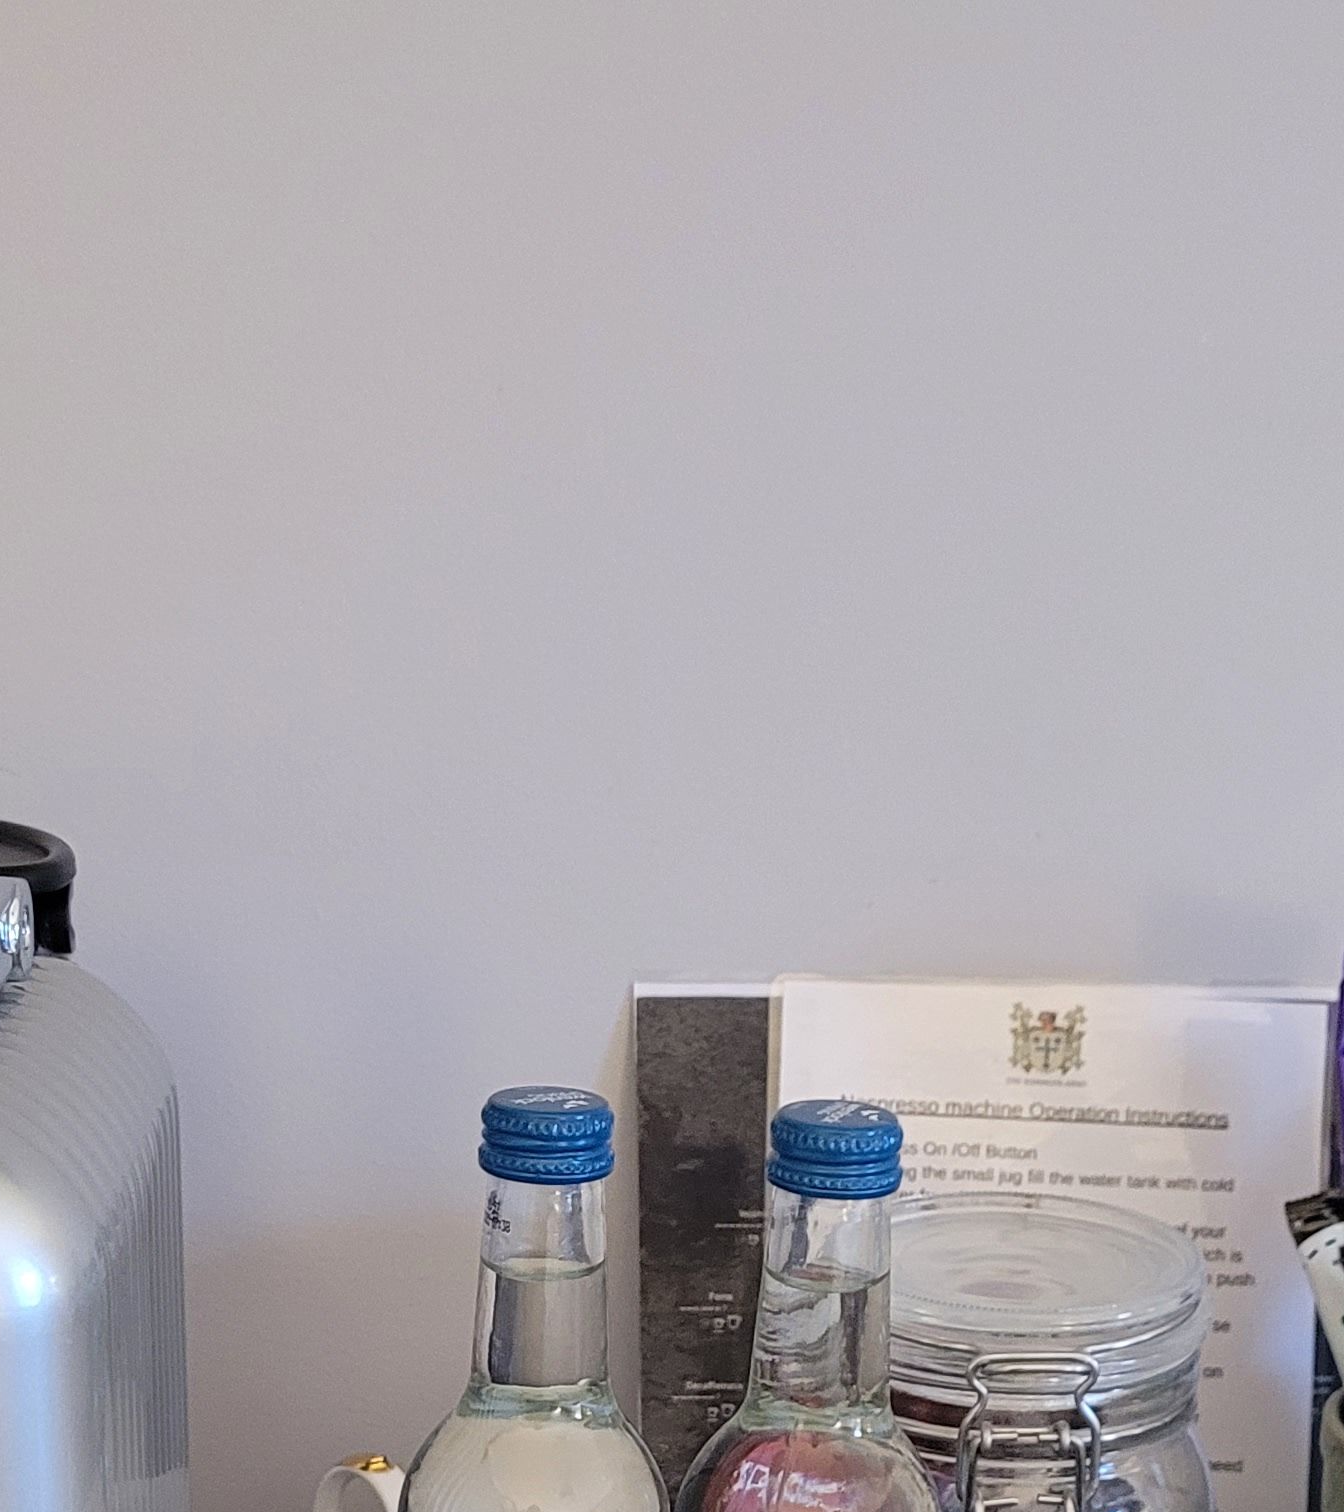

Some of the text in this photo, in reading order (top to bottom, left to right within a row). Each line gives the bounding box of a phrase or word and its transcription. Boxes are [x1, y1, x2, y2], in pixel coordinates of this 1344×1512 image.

[946, 1099, 1023, 1115] machine
[1029, 1102, 1120, 1122] Operation
[1126, 1106, 1230, 1127] Instructions
[986, 1143, 1038, 1161] Button
